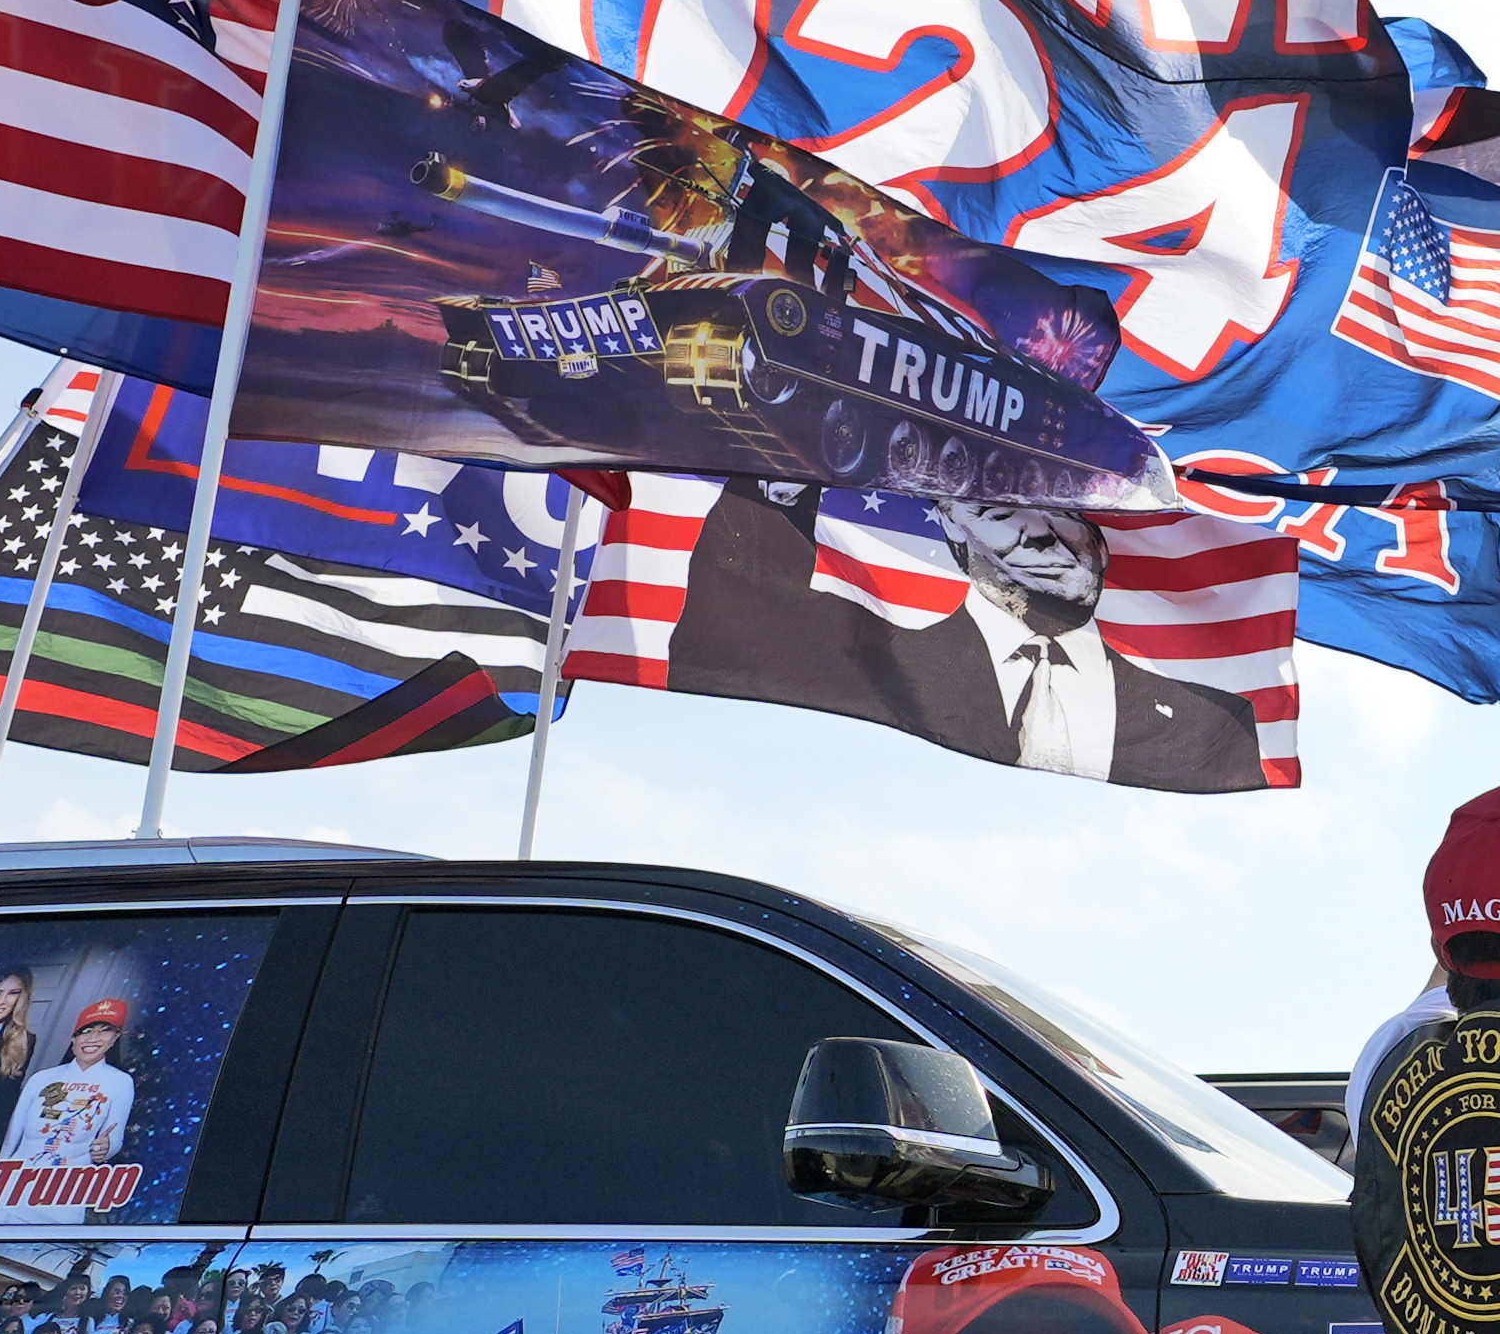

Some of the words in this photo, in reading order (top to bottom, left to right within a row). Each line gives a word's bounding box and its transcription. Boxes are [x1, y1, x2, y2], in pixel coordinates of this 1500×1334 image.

[491, 299, 647, 341] TRUMP
[853, 318, 1025, 432] TRUMP
[1381, 1046, 1448, 1134] BORN
[1458, 1094, 1496, 1112] FOR
[932, 1248, 1000, 1277] KEEP
[1005, 1246, 1107, 1277] AMERICA
[940, 1255, 1039, 1285] GREAT!
[1232, 1264, 1288, 1274] TRUMP
[1300, 1266, 1358, 1278] TRUMP
